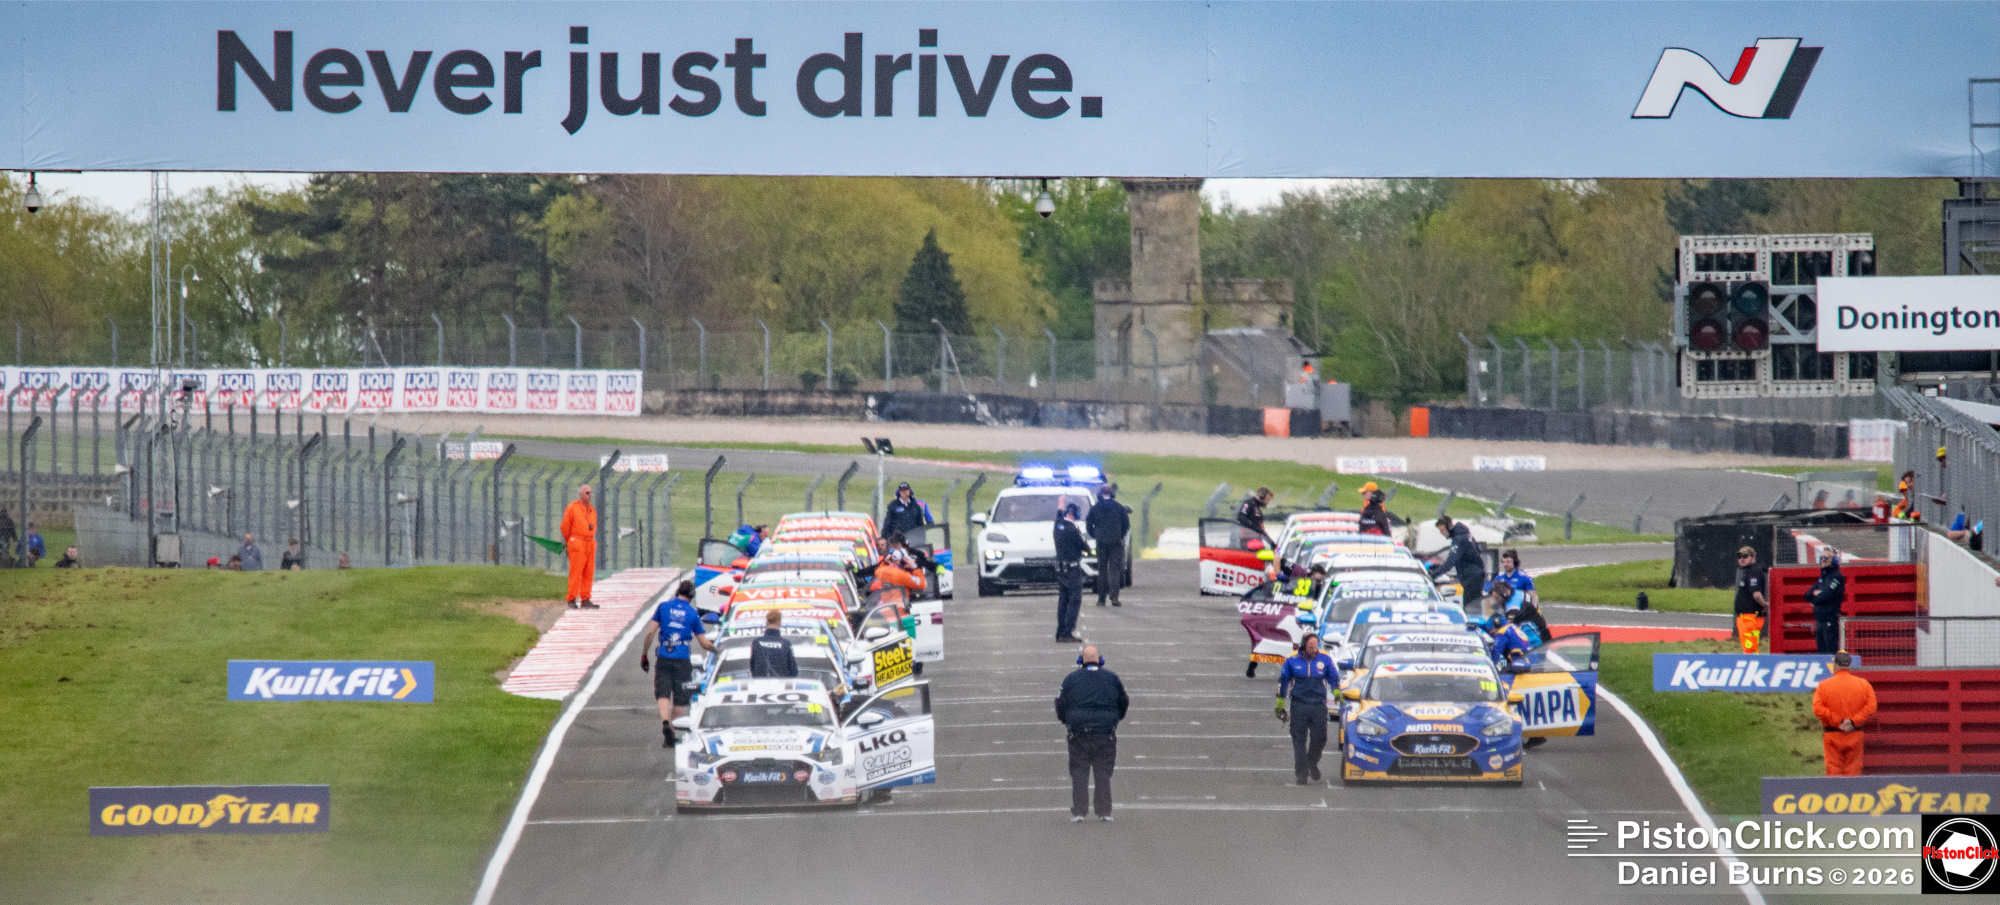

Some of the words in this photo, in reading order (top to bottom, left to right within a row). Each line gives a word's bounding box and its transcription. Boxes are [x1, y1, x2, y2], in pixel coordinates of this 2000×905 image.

[217, 29, 542, 115] Never
[560, 26, 767, 136] just
[796, 28, 1103, 119] drive.
[1837, 304, 2000, 336] Donington
[218, 374, 254, 391] LIQUI
[267, 374, 301, 391] LIQUI
[312, 373, 348, 391] LIQUI
[359, 373, 395, 391] LIQUI
[405, 372, 439, 390] LIQUI
[449, 371, 480, 390] LIQUI
[358, 390, 394, 408] MOLY
[403, 390, 439, 408] MOLY
[1293, 578, 1312, 596] 33
[1238, 601, 1284, 616] CLEAN
[1367, 611, 1453, 624] LKQ
[1405, 635, 1478, 645] Valvoline
[874, 641, 906, 672] Steel
[1413, 665, 1488, 674] Valvoline
[721, 692, 810, 704] LKQ
[1414, 707, 1457, 715] NAPA
[1517, 688, 1578, 727] NAPA
[1405, 724, 1433, 732] AUTO
[1432, 724, 1465, 733] PARTS
[858, 729, 908, 754] LKQ
[867, 769, 885, 780] CAR
[884, 761, 911, 776] PARTS
[1773, 789, 1991, 815] GOODYEAR
[101, 799, 321, 827] GOODYEAR
